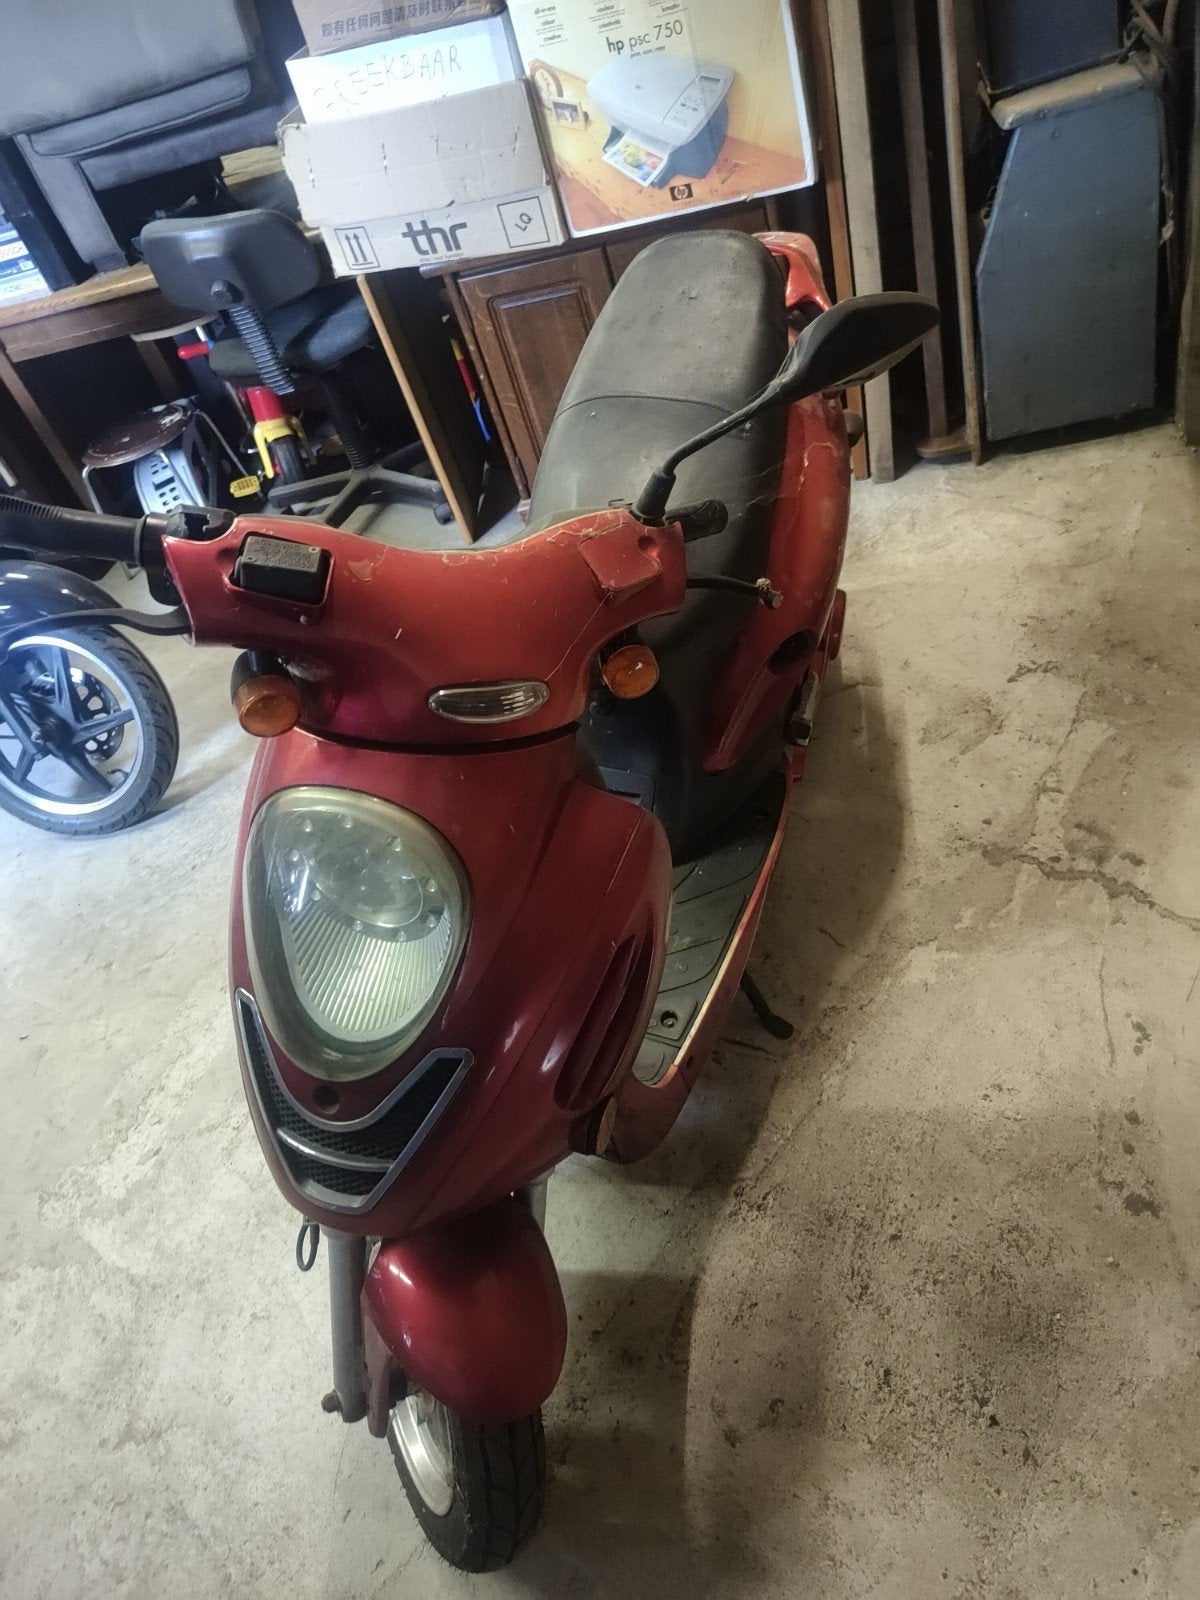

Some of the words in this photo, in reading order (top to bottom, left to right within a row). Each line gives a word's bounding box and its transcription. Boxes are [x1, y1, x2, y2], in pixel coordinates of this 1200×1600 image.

[606, 36, 625, 56] hp
[628, 33, 651, 52] psc
[653, 19, 683, 41] 750
[401, 219, 468, 256] thr
[514, 212, 534, 232] LQ
